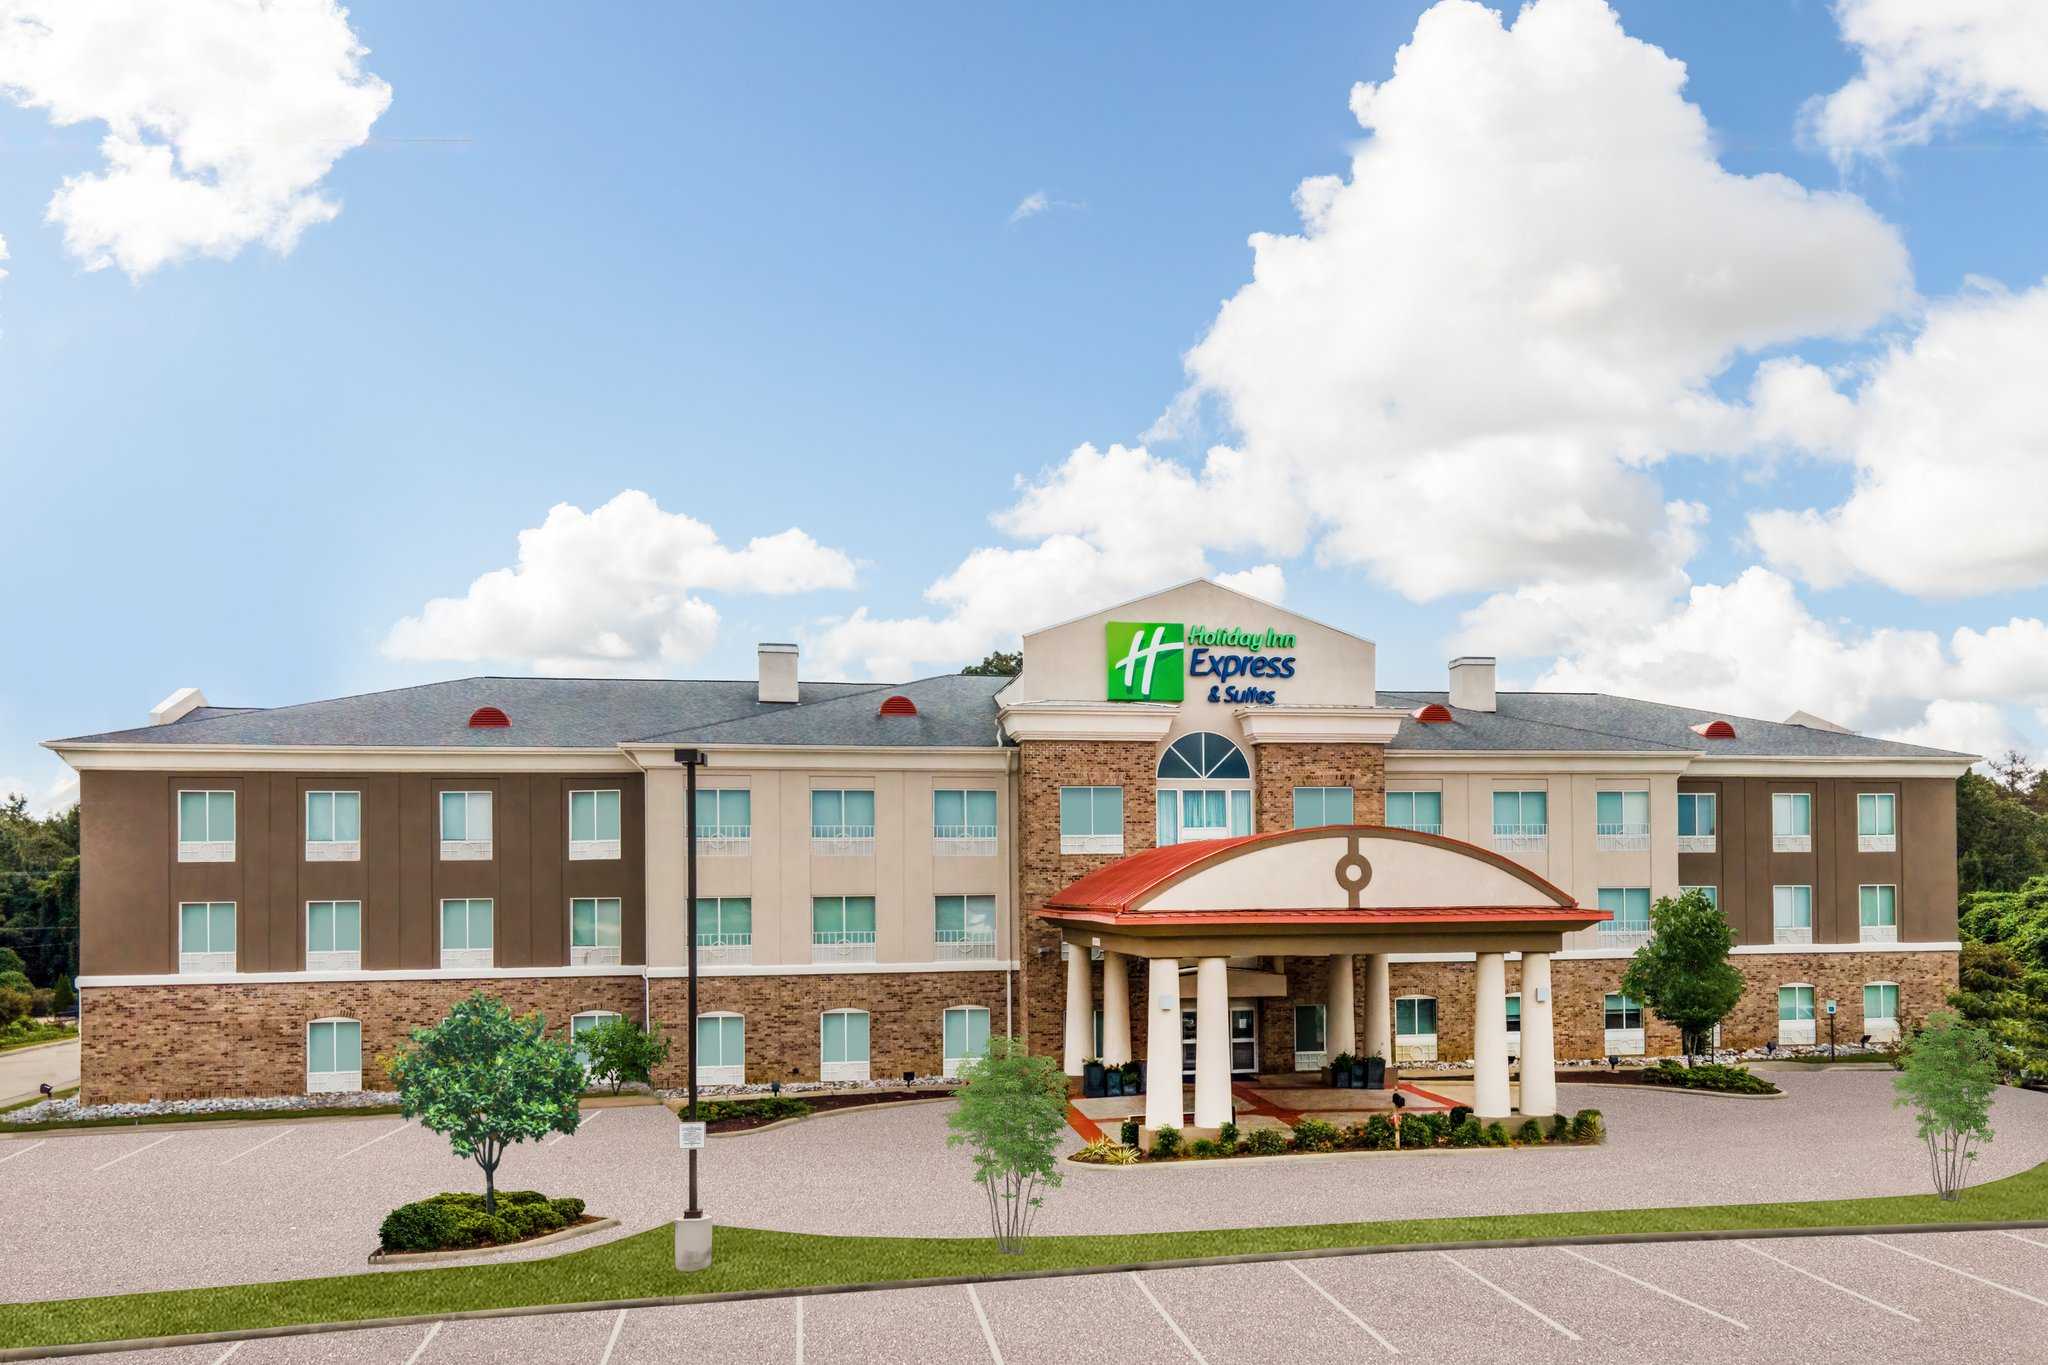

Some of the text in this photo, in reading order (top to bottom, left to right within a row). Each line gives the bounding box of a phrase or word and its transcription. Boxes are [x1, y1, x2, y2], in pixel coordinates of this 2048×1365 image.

[1187, 625, 1297, 651] Holiday Inn
[1190, 648, 1296, 683] Express
[1207, 685, 1276, 704] & Suites
